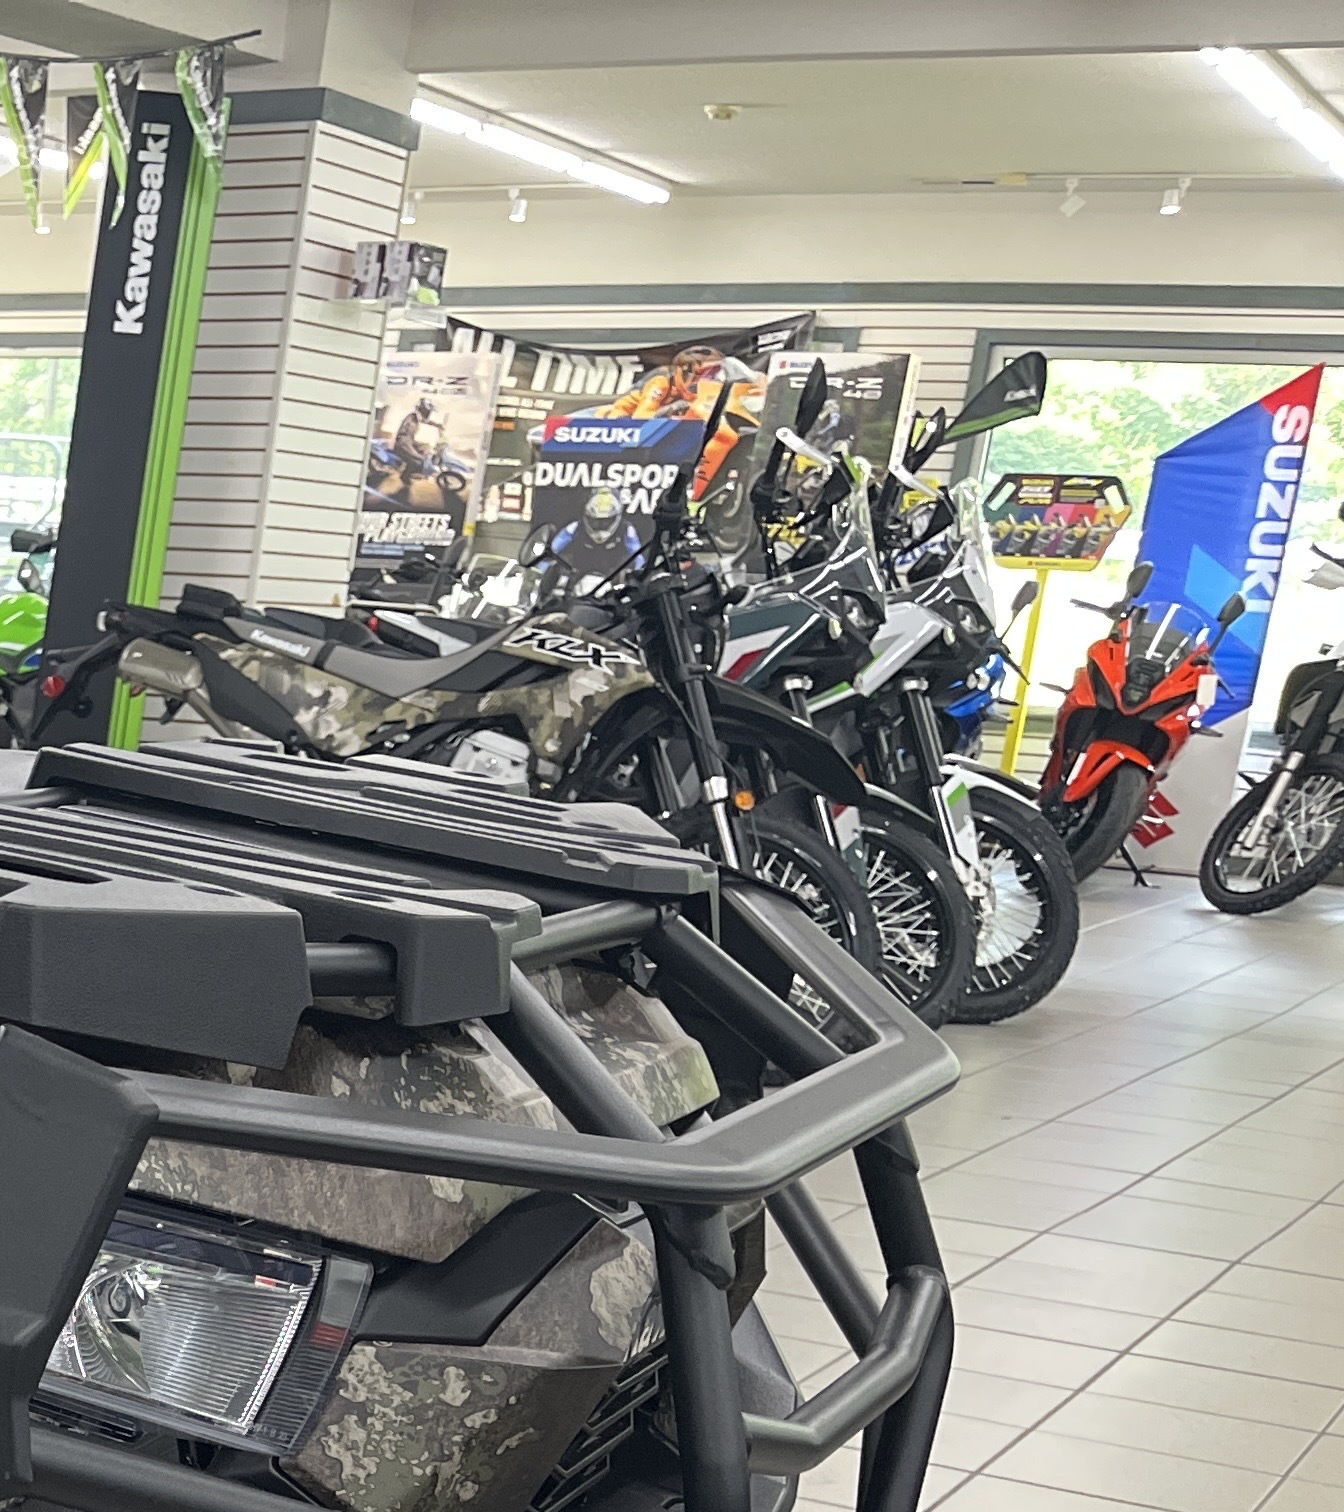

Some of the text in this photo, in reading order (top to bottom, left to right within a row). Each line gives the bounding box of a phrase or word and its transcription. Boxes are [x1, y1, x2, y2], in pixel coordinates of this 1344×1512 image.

[113, 122, 172, 335] Kawasaki
[553, 426, 641, 443] SUZUKI
[1243, 403, 1312, 614] SUZUKI
[502, 627, 643, 677] KLX
